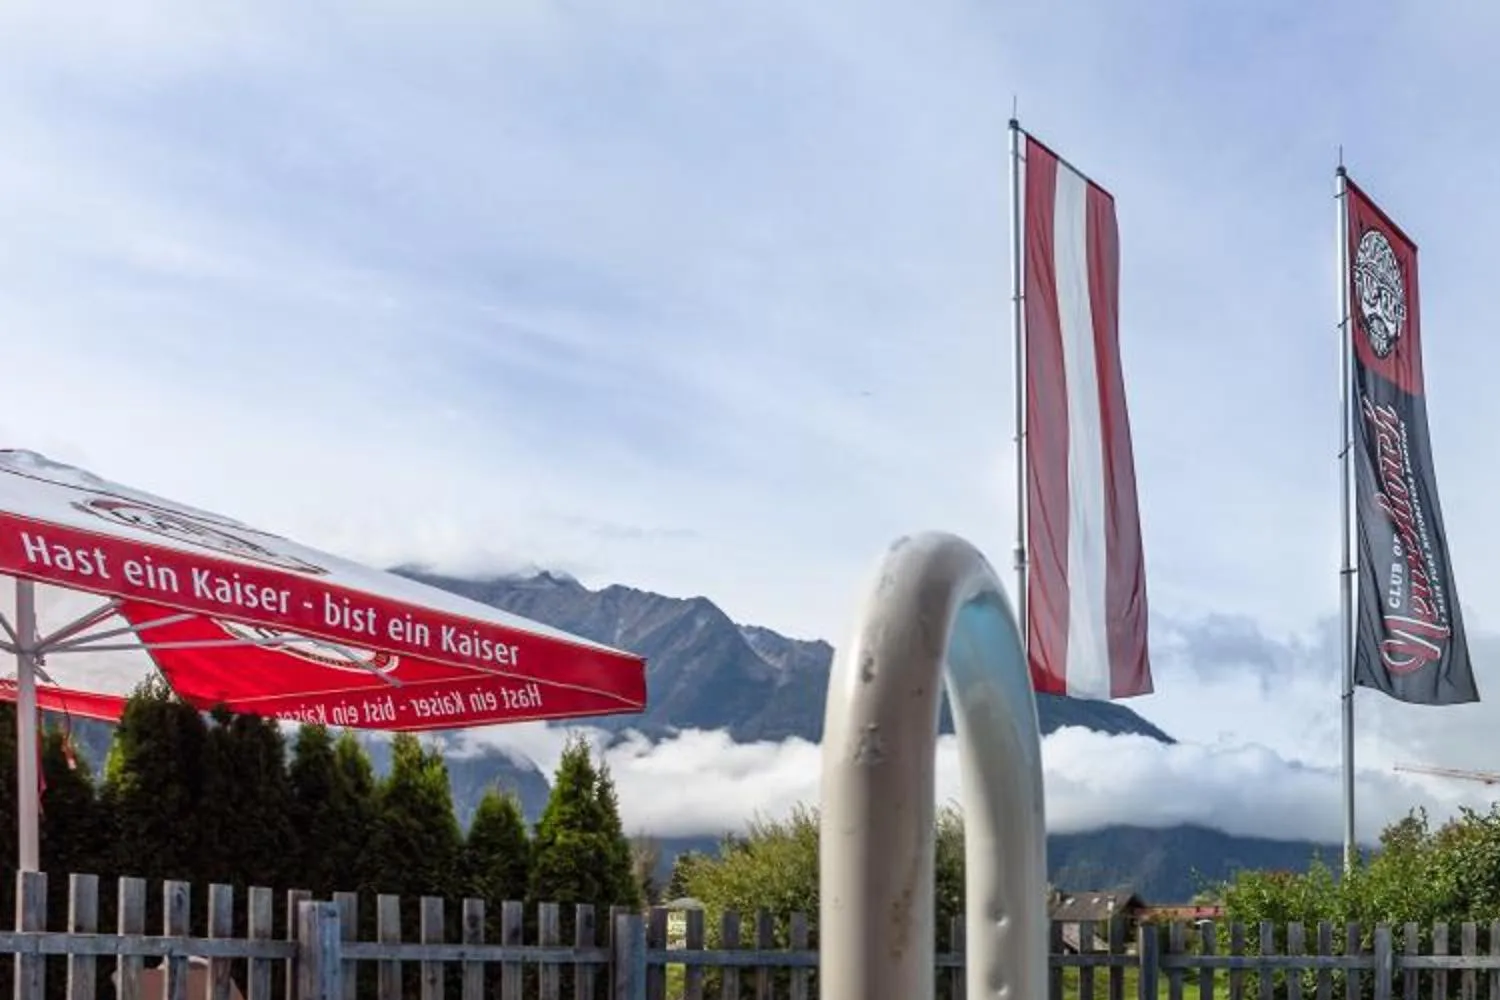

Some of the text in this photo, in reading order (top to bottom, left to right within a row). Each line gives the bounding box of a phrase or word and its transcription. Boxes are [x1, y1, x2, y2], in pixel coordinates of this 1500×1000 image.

[20, 531, 111, 580] Hast
[124, 556, 179, 593] ein
[191, 567, 291, 614] Kaiser
[324, 592, 377, 636] bist
[388, 614, 431, 647] ein
[440, 625, 520, 666] Kaiser
[1389, 563, 1403, 609] CLUB
